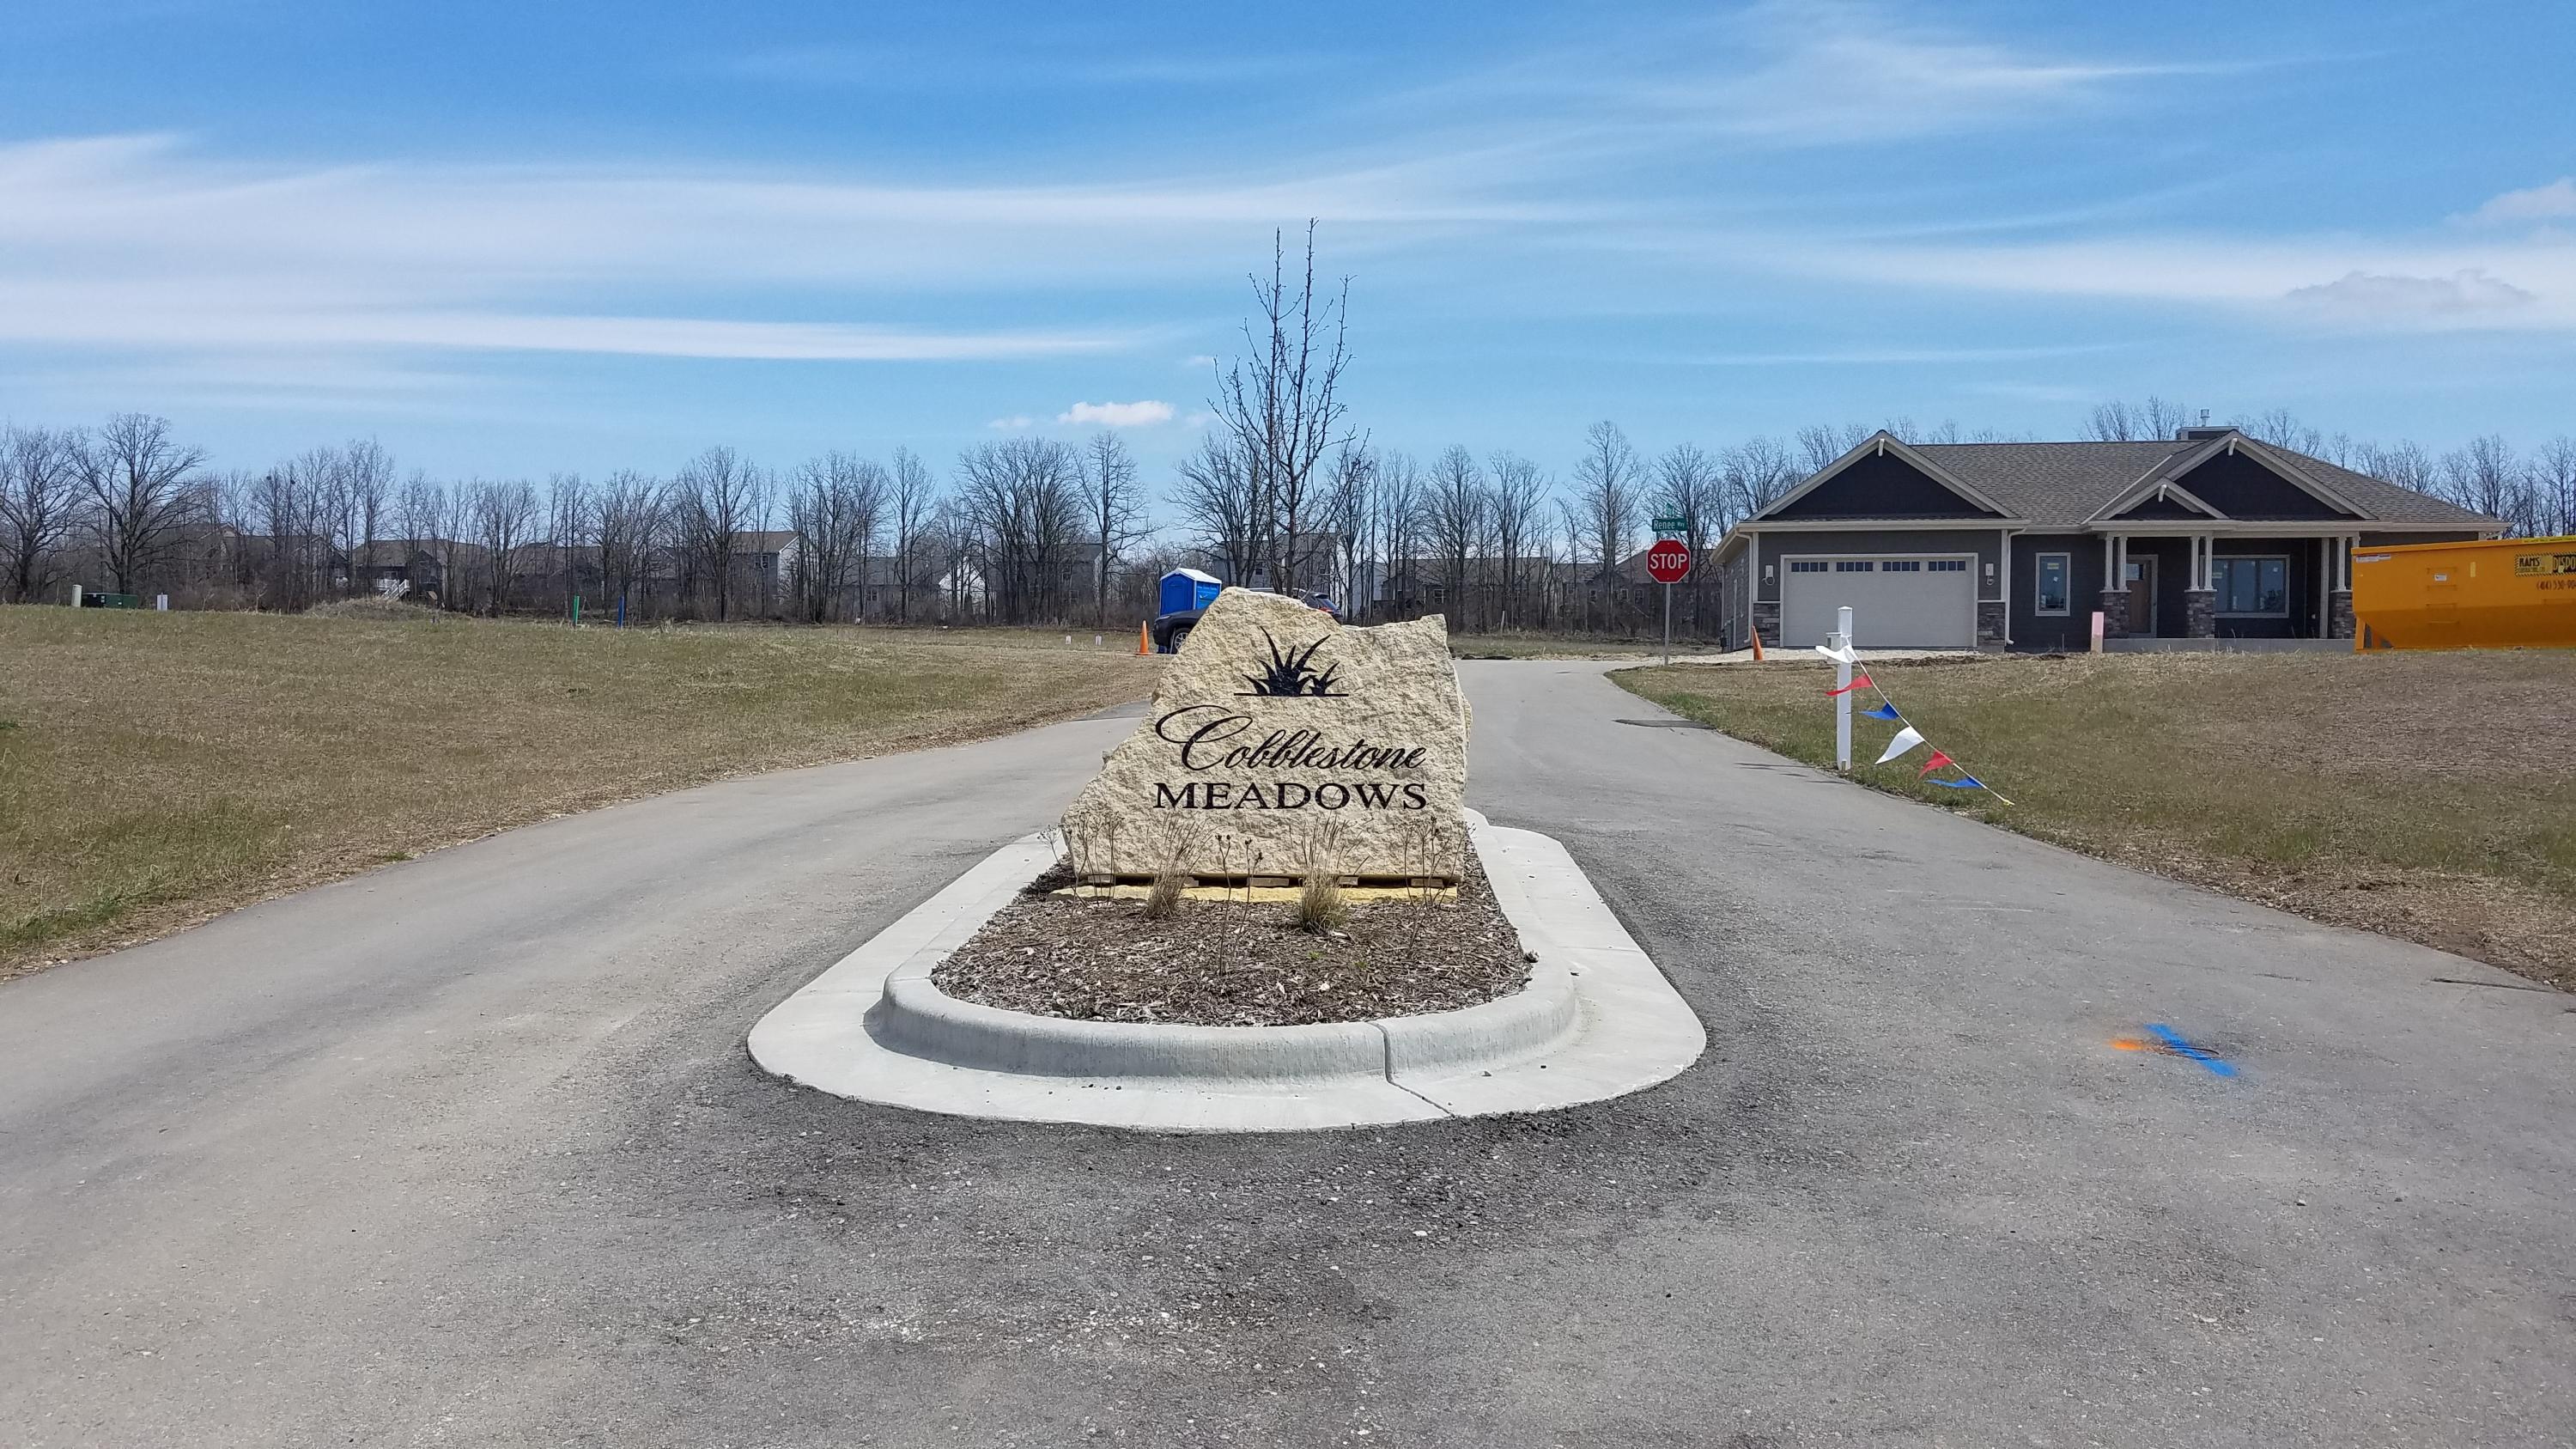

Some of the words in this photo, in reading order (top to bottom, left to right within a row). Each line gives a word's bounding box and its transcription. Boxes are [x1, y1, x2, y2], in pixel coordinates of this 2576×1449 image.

[1653, 520, 1675, 530] Renee
[1649, 553, 1687, 569] STOP
[1155, 704, 1426, 771] Cobblestone
[1153, 782, 1427, 810] MEADOWS
